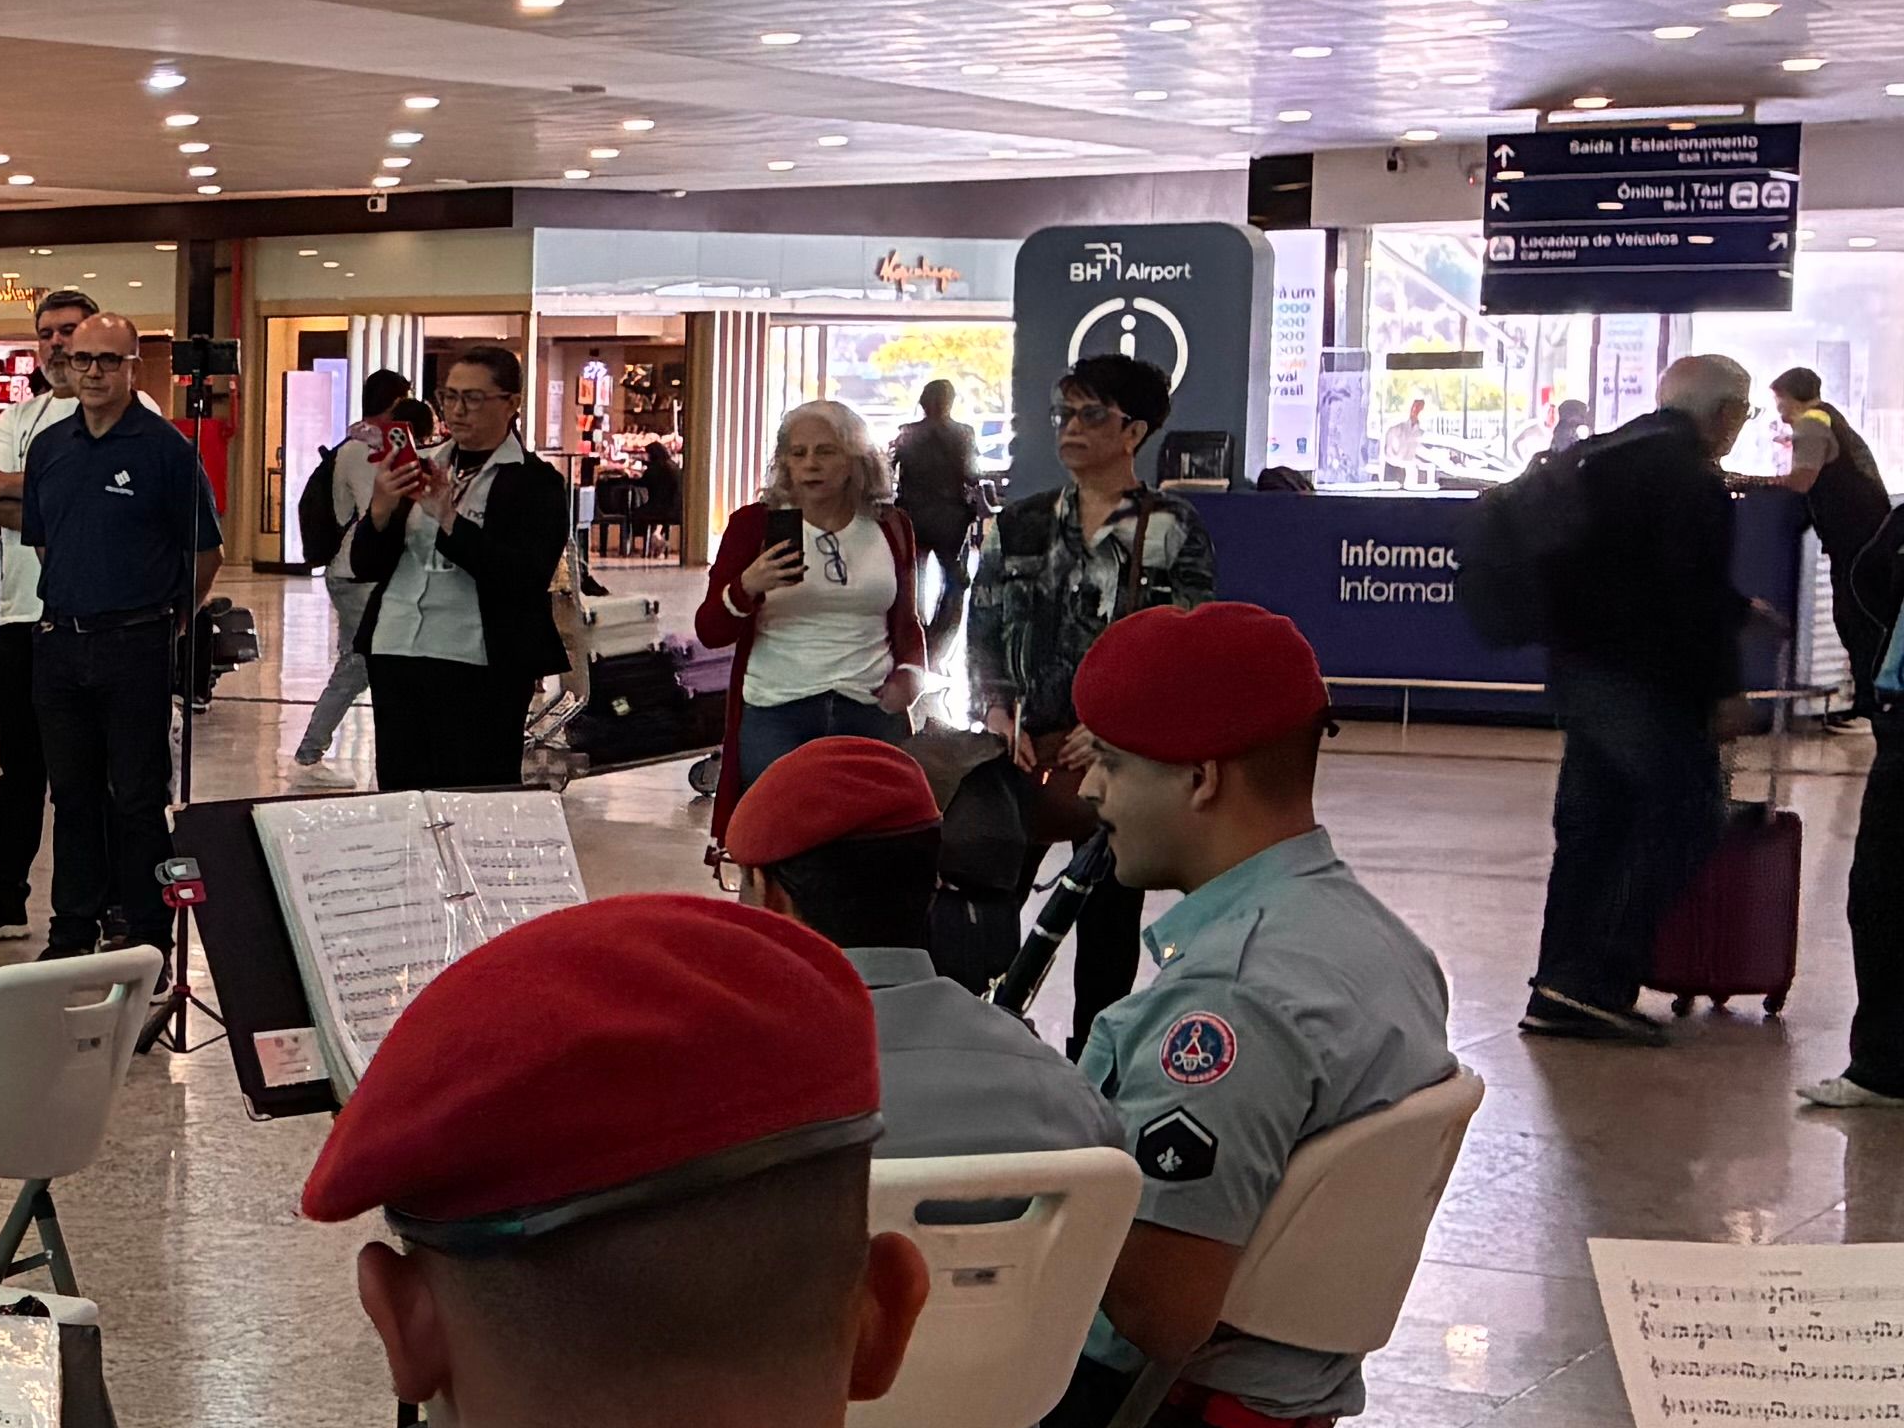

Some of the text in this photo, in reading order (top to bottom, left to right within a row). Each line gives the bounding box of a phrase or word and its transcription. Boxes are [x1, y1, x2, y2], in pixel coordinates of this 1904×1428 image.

[1631, 134, 1758, 153] Estacionamento
[1617, 181, 1674, 200] Ônibus
[1520, 231, 1679, 249] Locadora de Veículos
[1070, 262, 1192, 283] BH Airport
